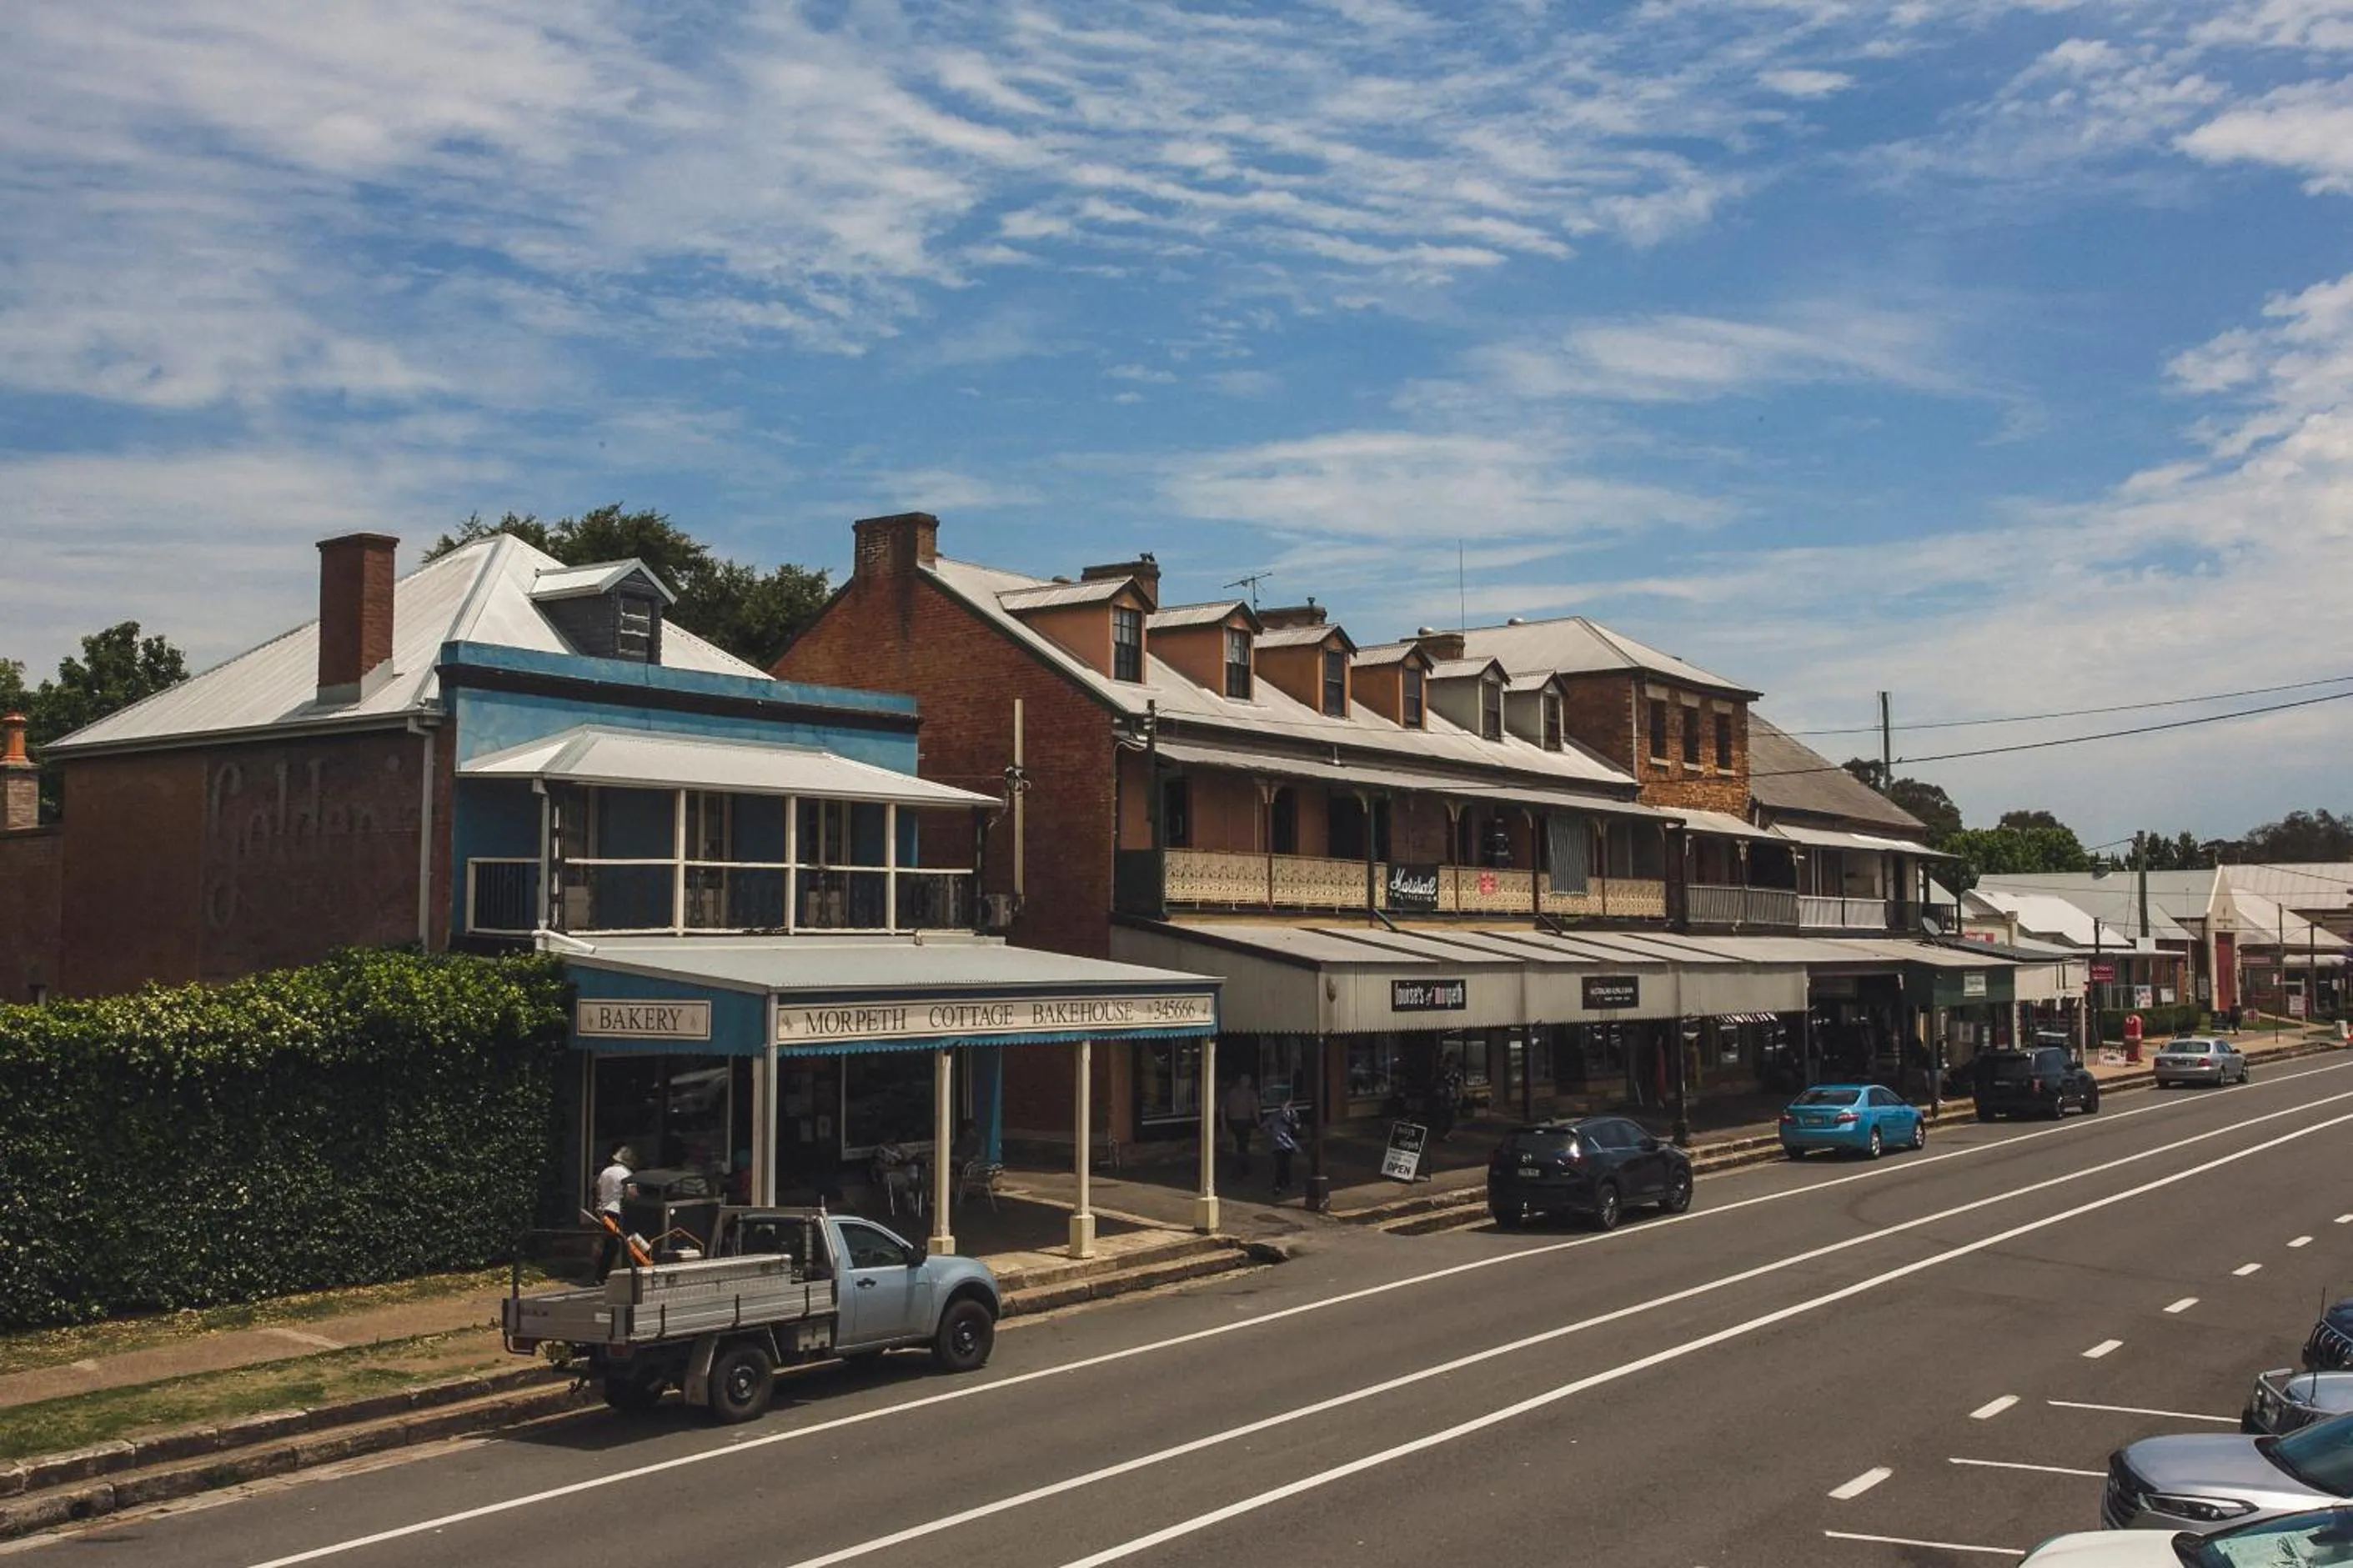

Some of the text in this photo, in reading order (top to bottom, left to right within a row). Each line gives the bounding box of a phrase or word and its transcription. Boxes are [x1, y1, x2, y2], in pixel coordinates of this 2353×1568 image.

[599, 1007, 683, 1031] BAKERY
[804, 999, 1196, 1034] MORPETH COTTAGE BAKEHOUSE 345666
